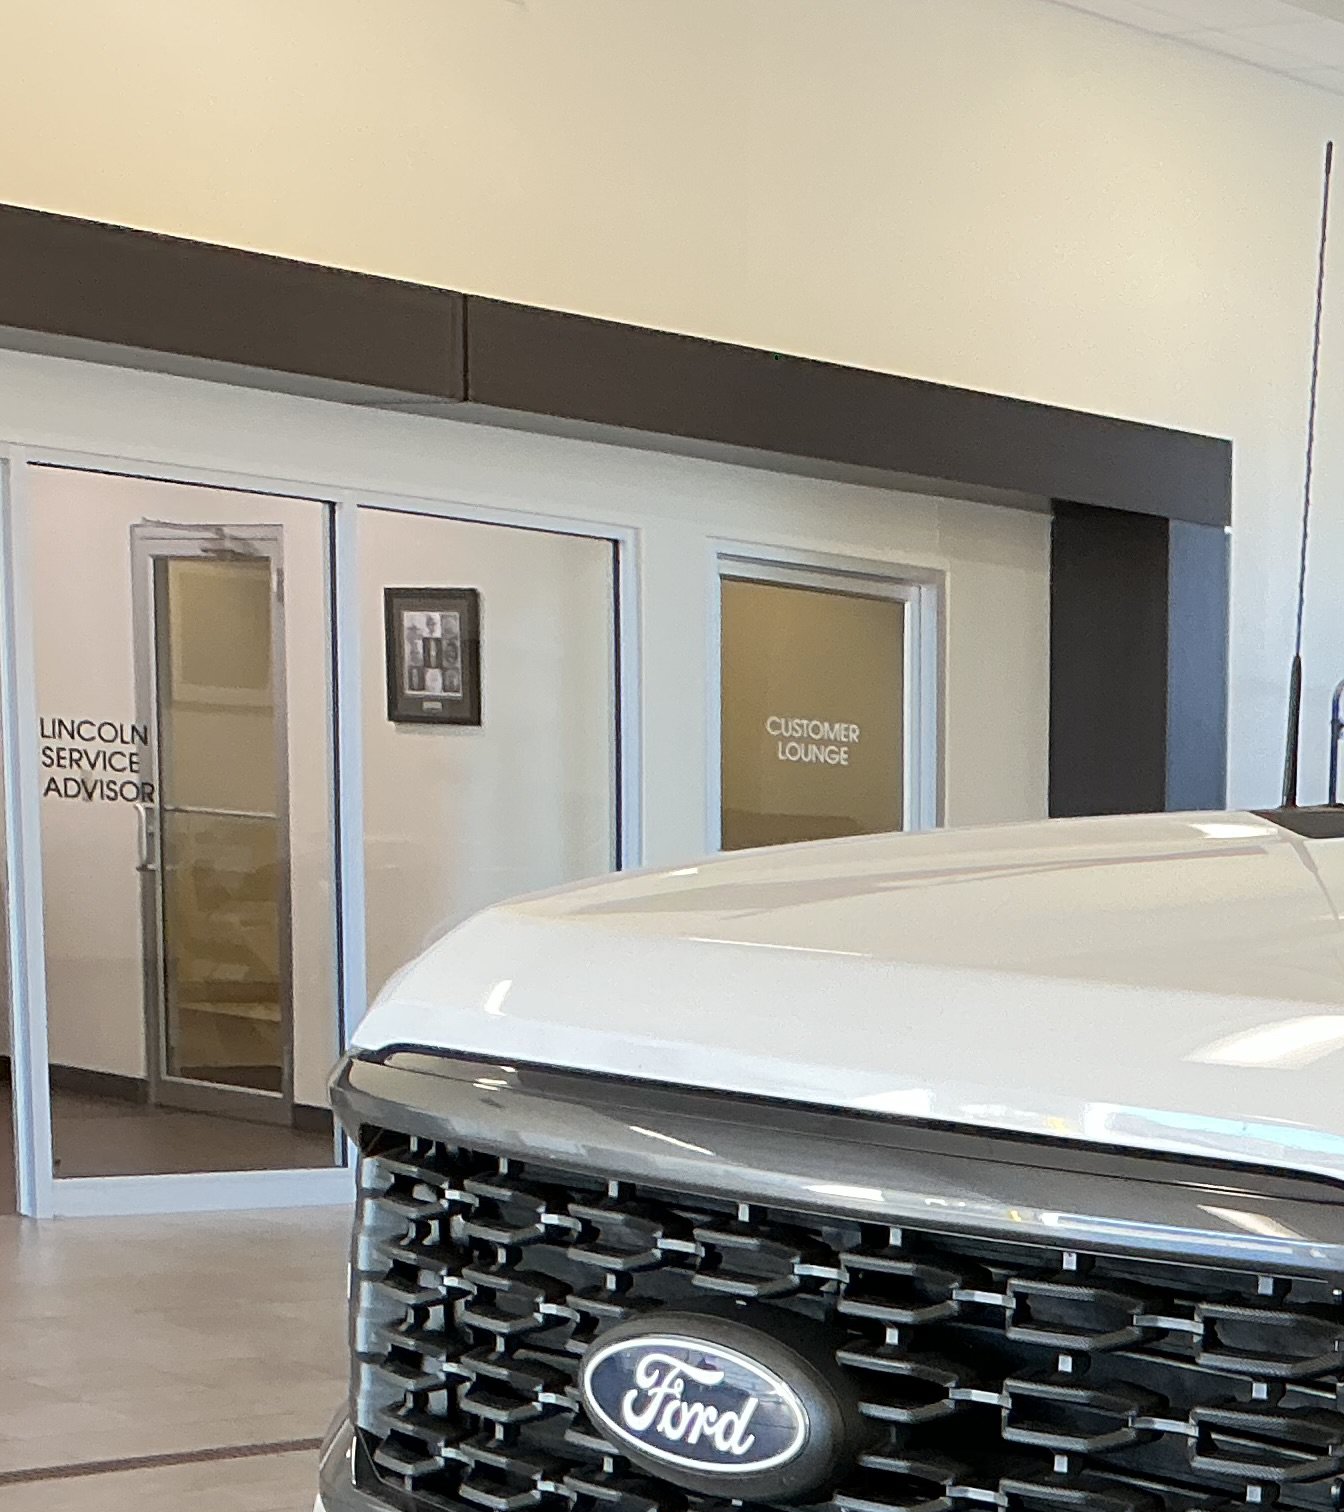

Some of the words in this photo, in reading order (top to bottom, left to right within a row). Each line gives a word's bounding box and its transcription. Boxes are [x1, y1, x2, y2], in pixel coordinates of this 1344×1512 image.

[40, 717, 149, 746] LINCOLN
[766, 715, 860, 743] CUSTOMER
[41, 745, 140, 774] SERVICE
[777, 741, 849, 766] LOUNGE
[43, 776, 155, 803] ADVISOR
[623, 1353, 760, 1456] Ford
